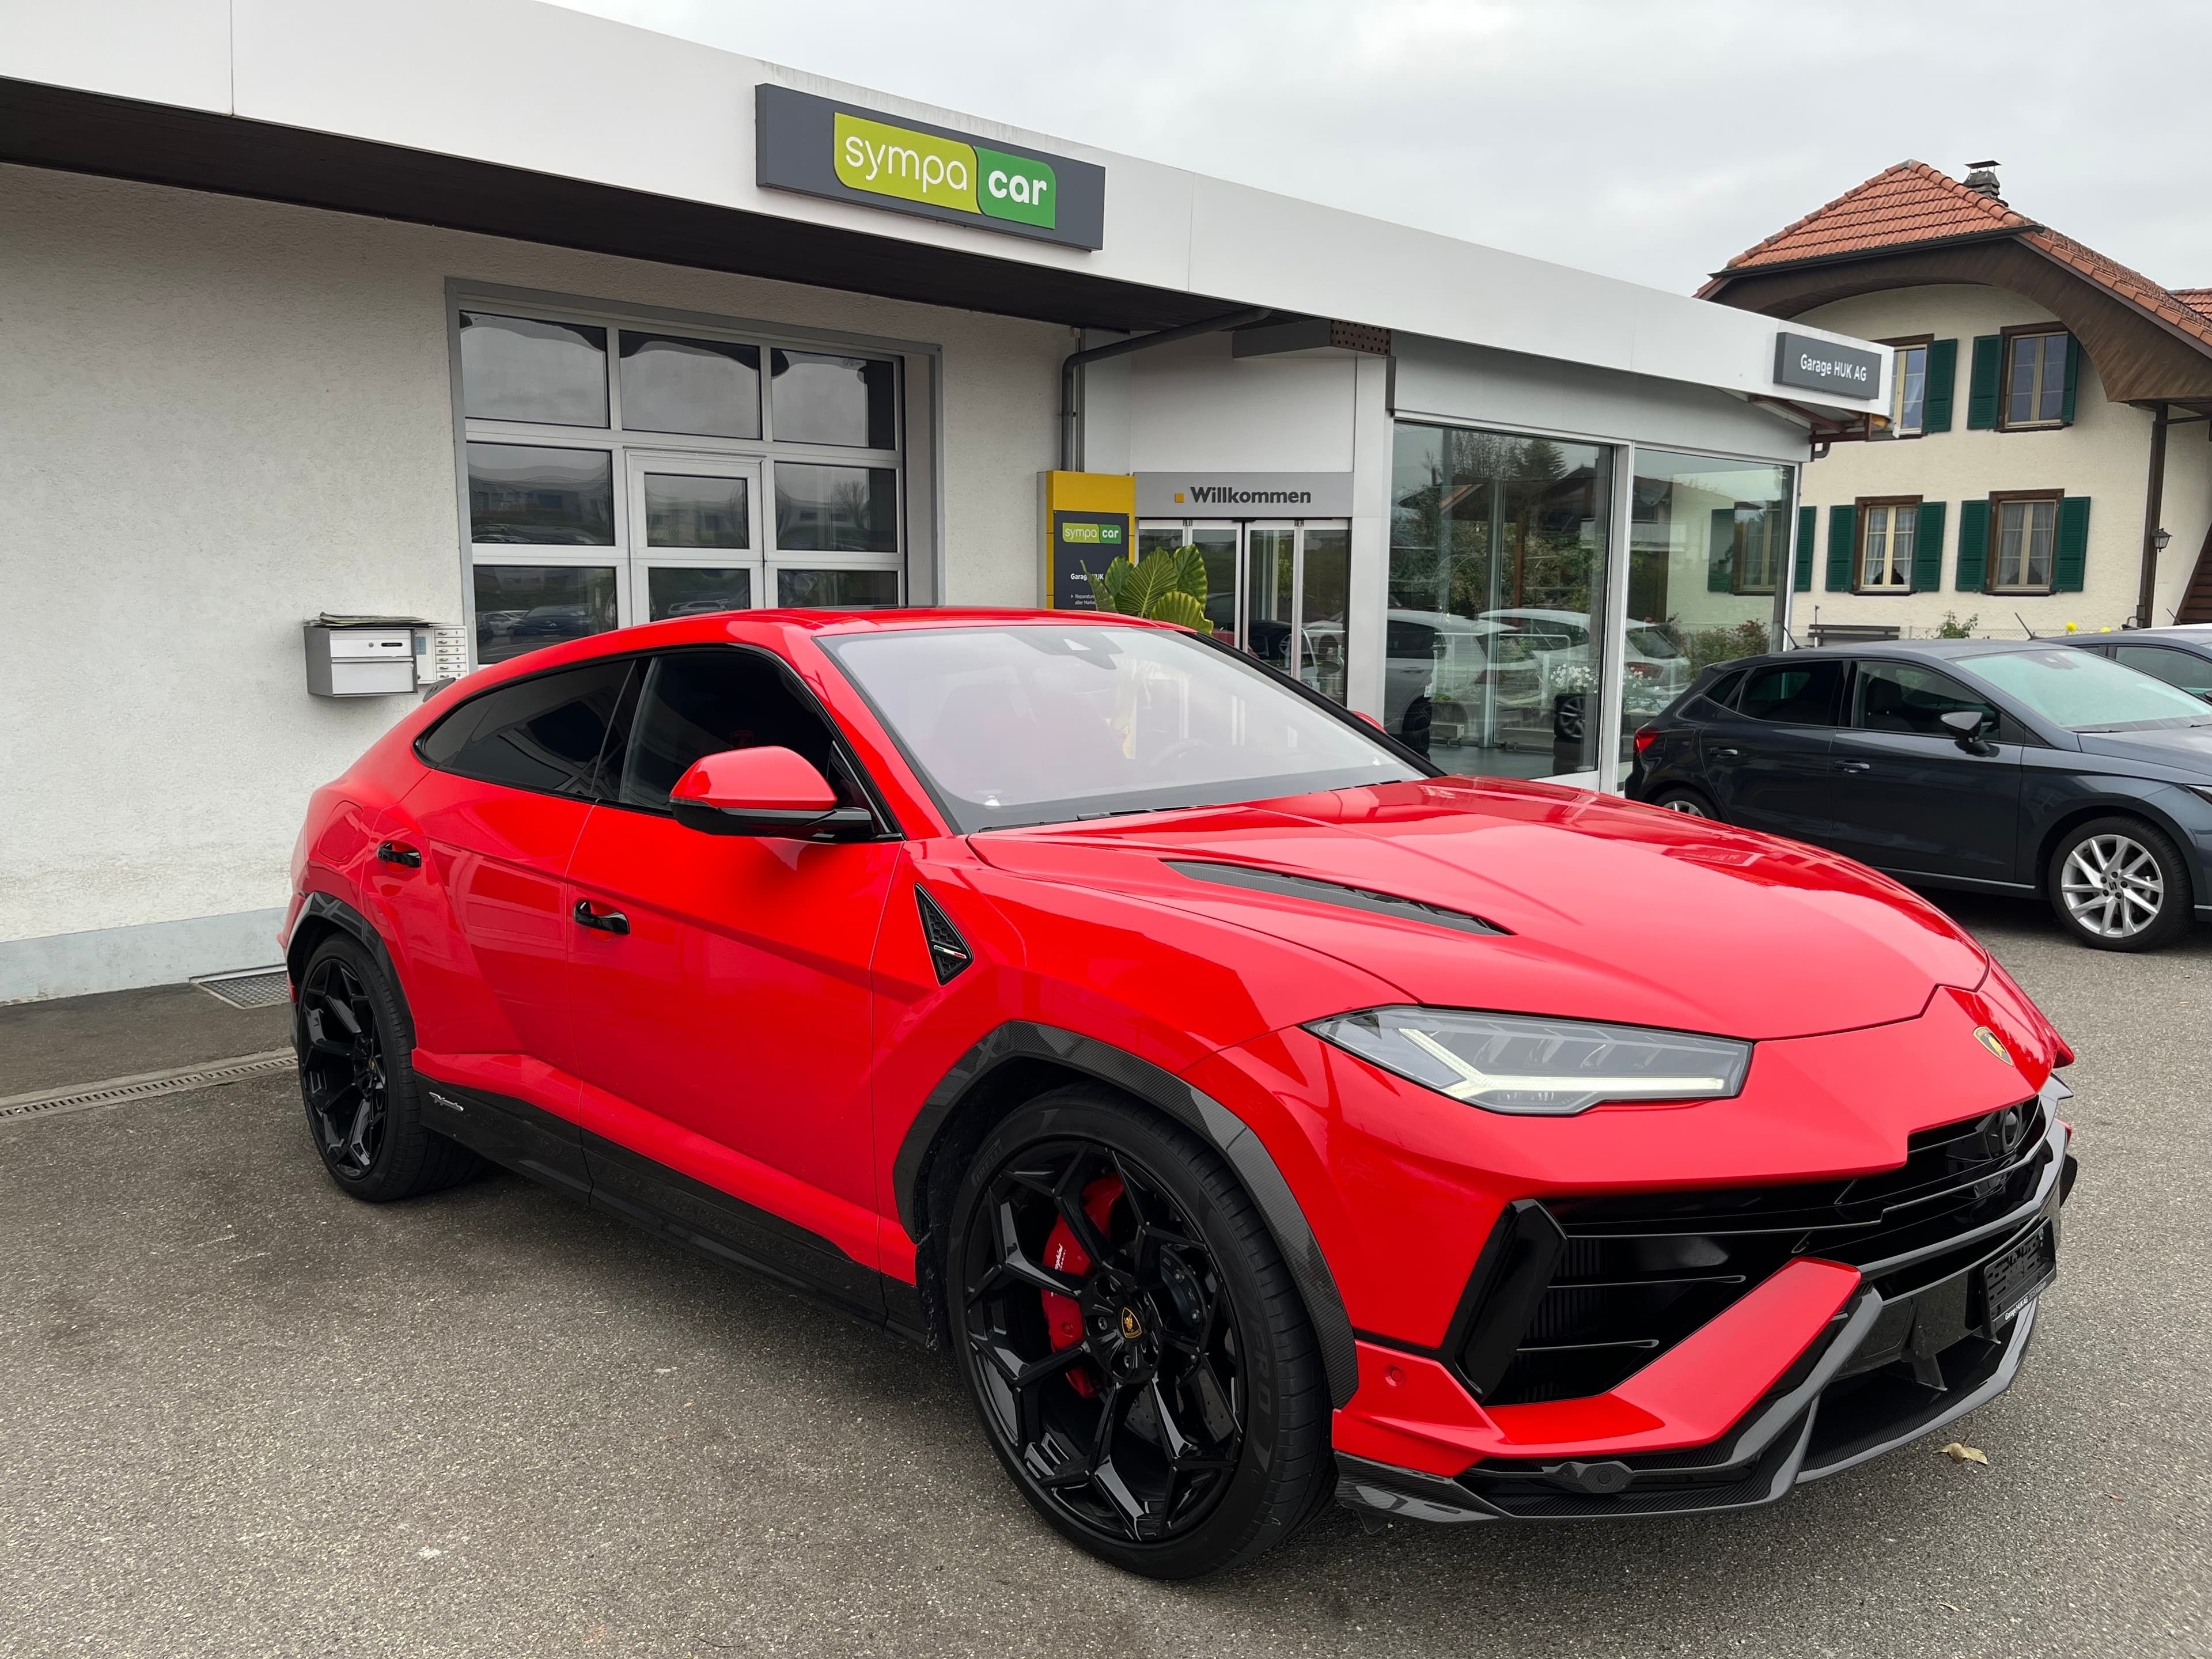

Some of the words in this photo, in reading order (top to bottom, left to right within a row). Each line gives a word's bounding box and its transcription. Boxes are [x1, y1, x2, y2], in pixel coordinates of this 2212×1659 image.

[845, 135, 967, 193] sympa
[988, 169, 1047, 206] car
[1800, 354, 1832, 376] Garage
[1834, 361, 1853, 379] HUK
[1854, 365, 1867, 381] AG
[1190, 487, 1311, 503] Willkommen
[1065, 528, 1097, 540] sympa
[1102, 529, 1119, 538] car
[1070, 573, 1088, 581] Garag
